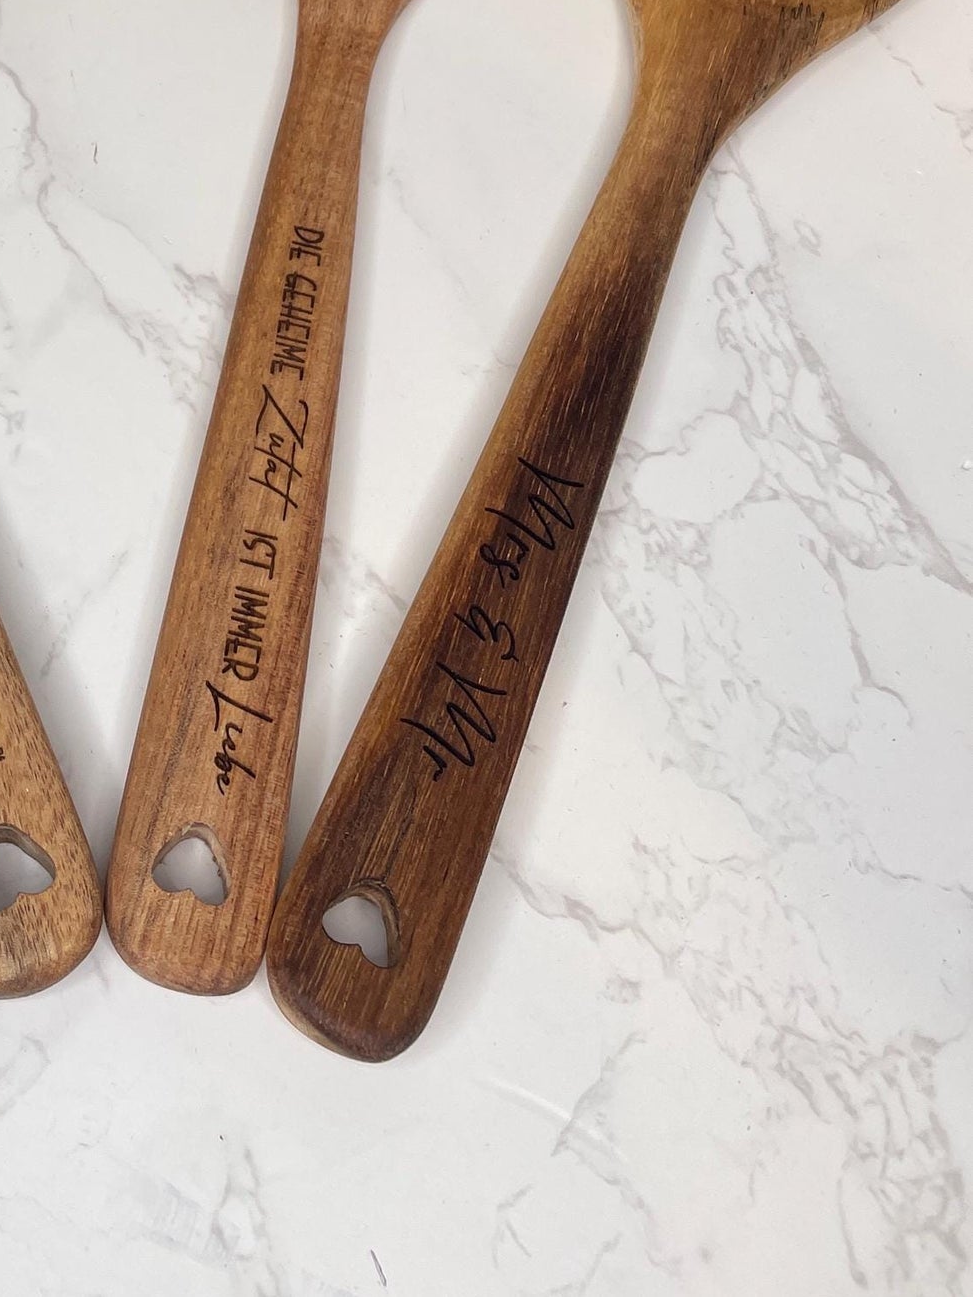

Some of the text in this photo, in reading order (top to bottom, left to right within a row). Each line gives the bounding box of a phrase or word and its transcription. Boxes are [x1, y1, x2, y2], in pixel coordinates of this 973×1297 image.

[206, 225, 325, 796] DIE GEHEIME Zutat IST IMMER Liebe
[400, 456, 584, 782] Mrs & Mr
